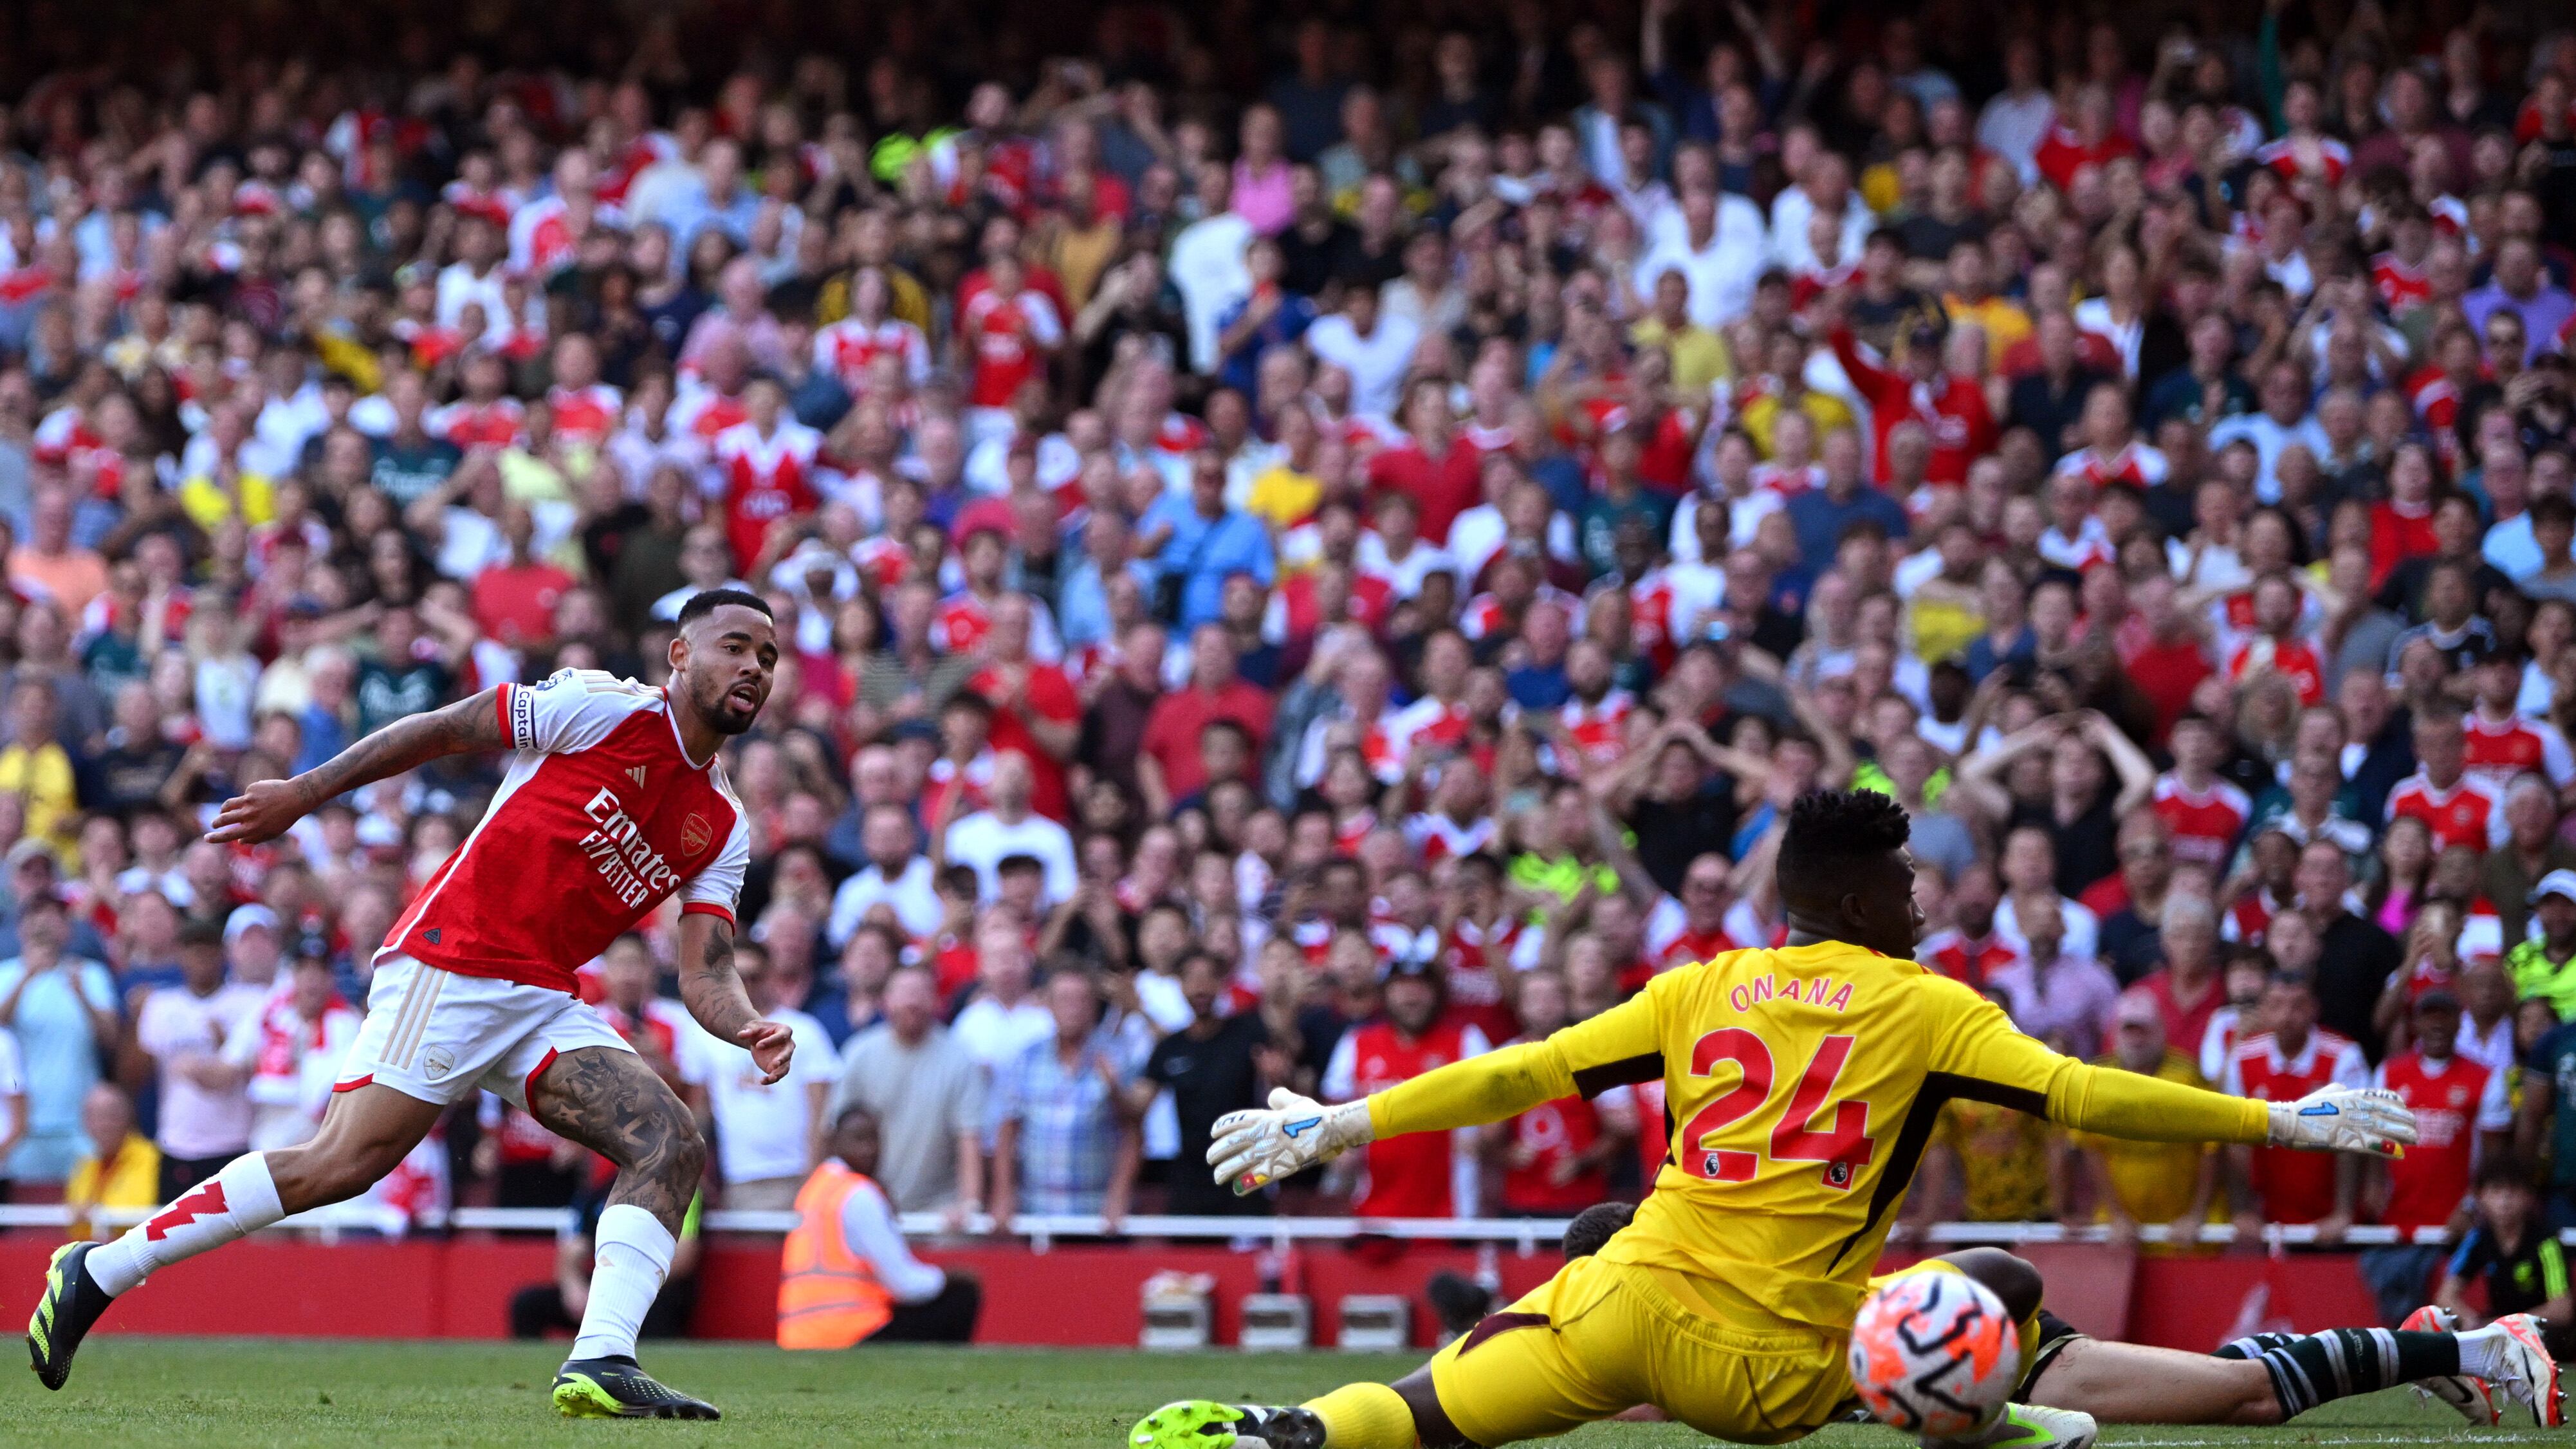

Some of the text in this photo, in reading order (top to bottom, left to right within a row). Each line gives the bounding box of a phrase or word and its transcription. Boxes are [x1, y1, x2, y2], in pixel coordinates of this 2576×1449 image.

[515, 691, 531, 749] Captain
[584, 785, 681, 894] Emirates
[1730, 974, 1854, 1013] ONANA
[1682, 1027, 1875, 1192] 24
